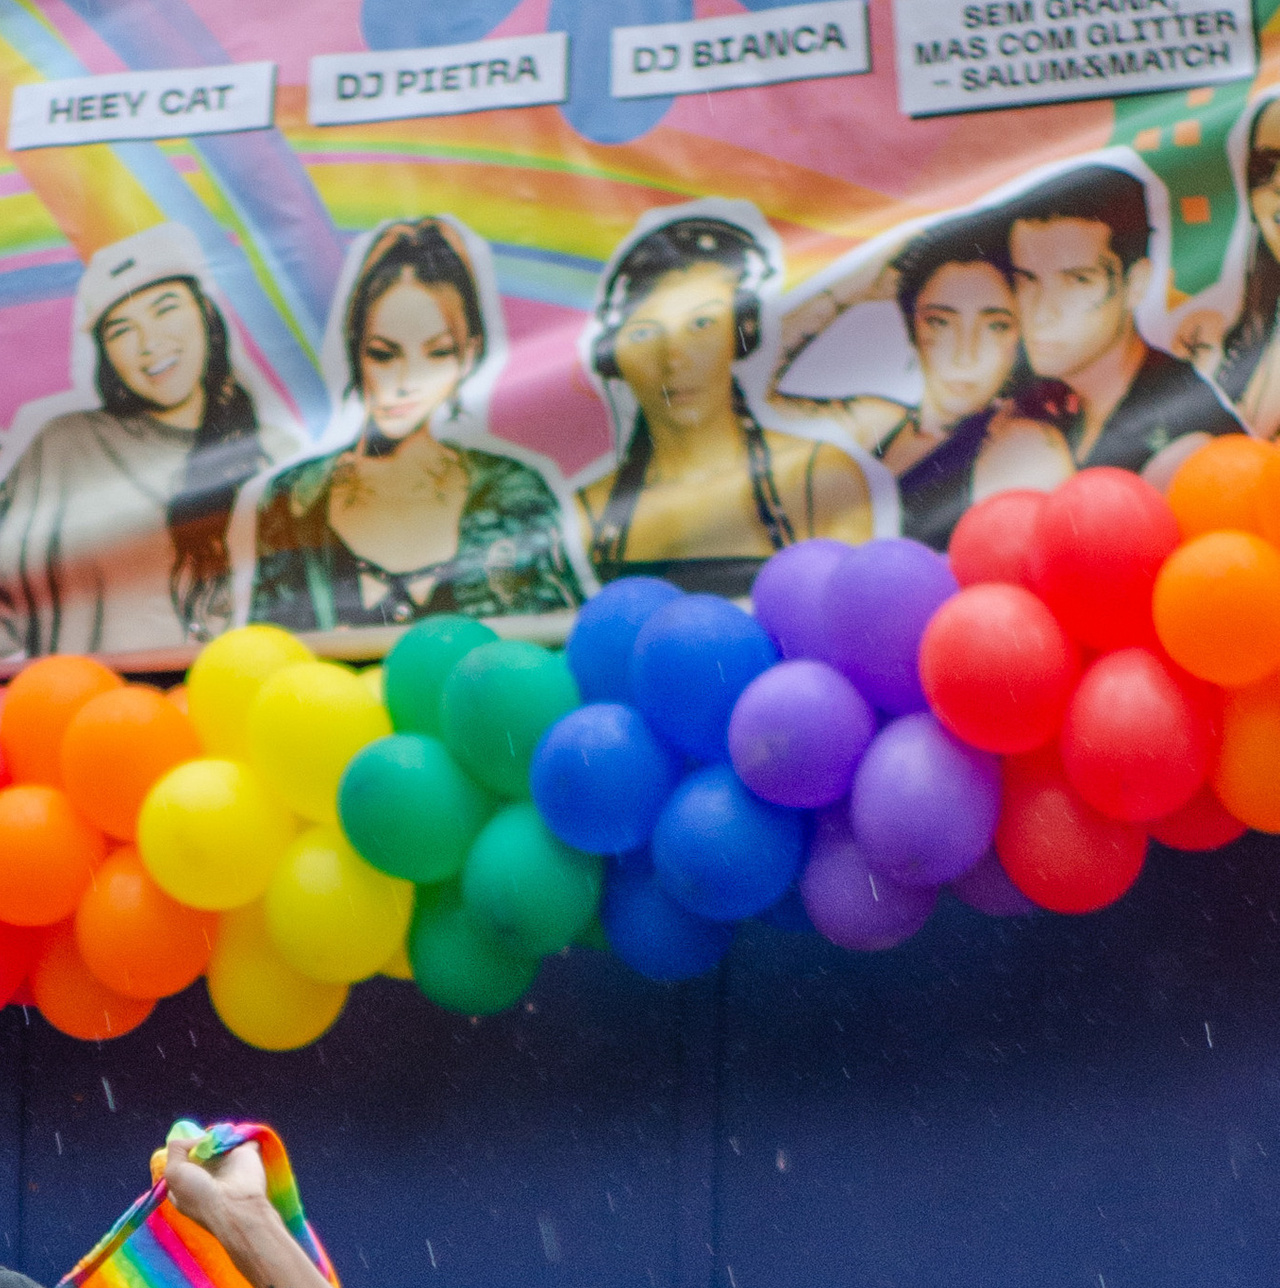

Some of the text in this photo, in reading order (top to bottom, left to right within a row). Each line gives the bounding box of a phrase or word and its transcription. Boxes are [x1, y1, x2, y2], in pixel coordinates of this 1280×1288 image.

[915, 10, 1237, 66] MAS COM GLITTER
[963, 0, 1035, 28] SEM
[632, 23, 847, 74] DJ BIANCA
[961, 41, 1232, 91] SALUM&MATCH
[336, 55, 540, 101] DJ PIETRA
[48, 84, 235, 124] HEEY CAT
